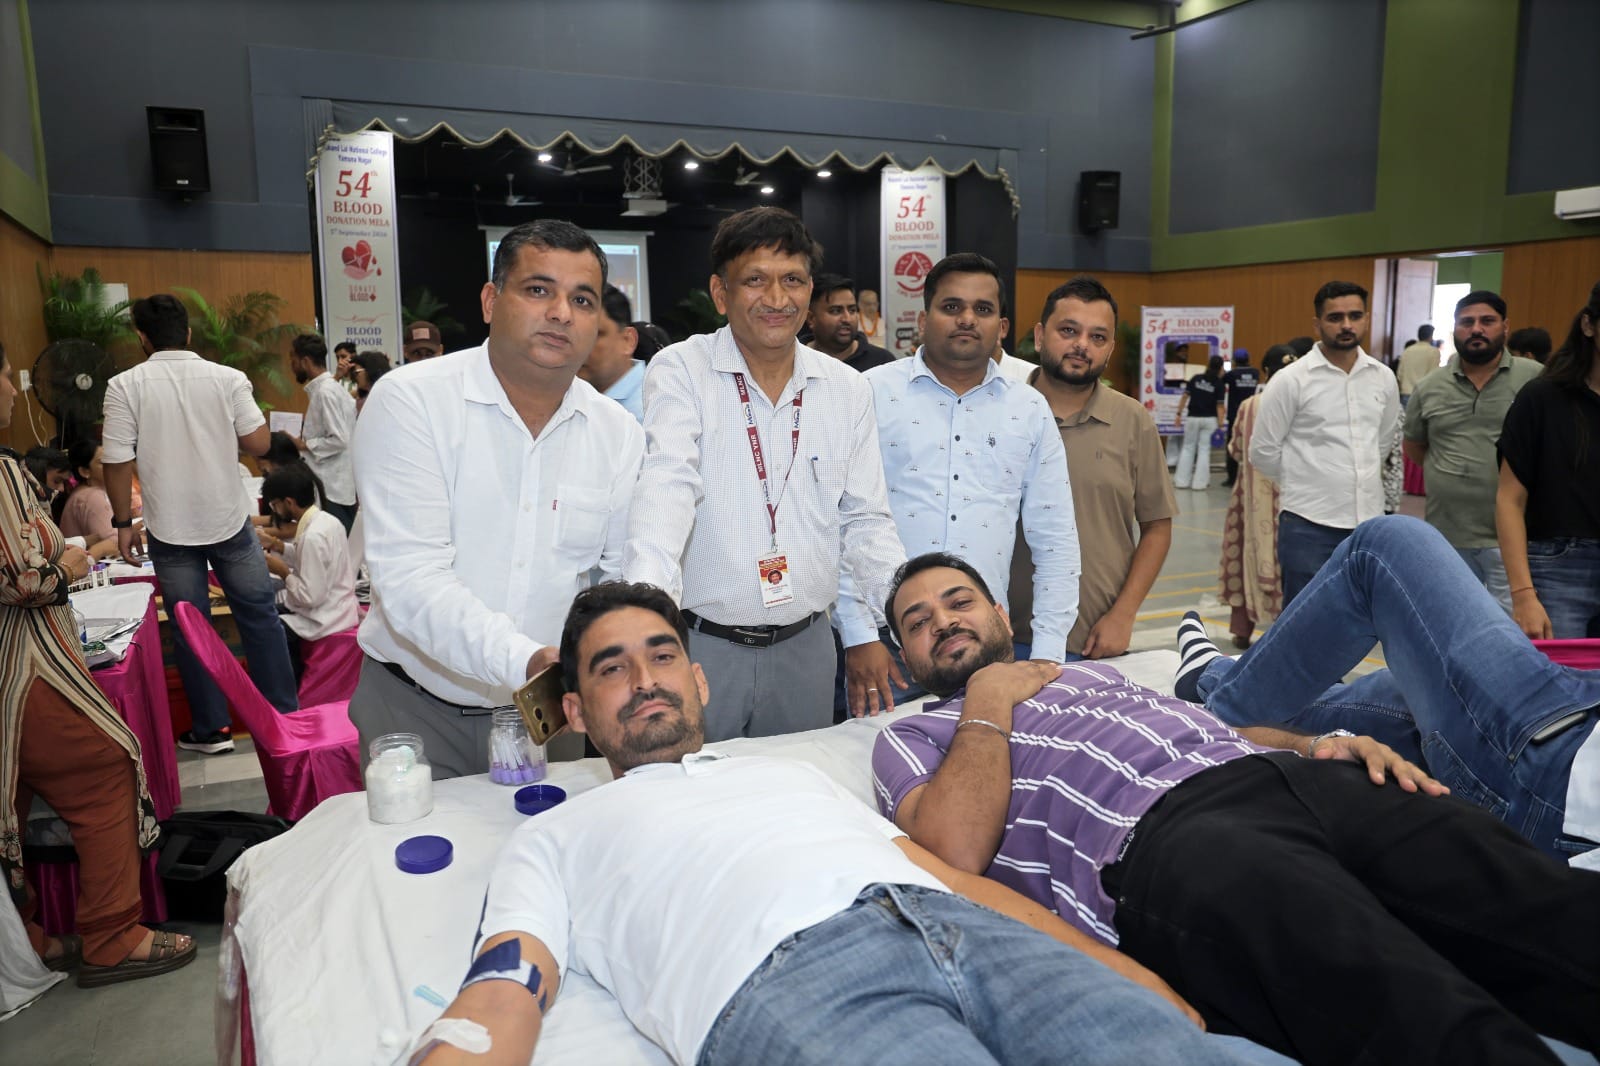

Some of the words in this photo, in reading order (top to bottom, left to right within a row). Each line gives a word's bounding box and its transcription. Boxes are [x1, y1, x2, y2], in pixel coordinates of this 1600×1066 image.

[333, 201, 383, 215] BLOOD
[326, 216, 366, 225] DONATION
[895, 221, 935, 232] BLOOD
[350, 293, 368, 302] BLOOD
[1177, 319, 1220, 328] BLOOD
[346, 327, 381, 335] BLOOD
[736, 376, 746, 396] MLNC
[754, 453, 764, 472] MLNC
